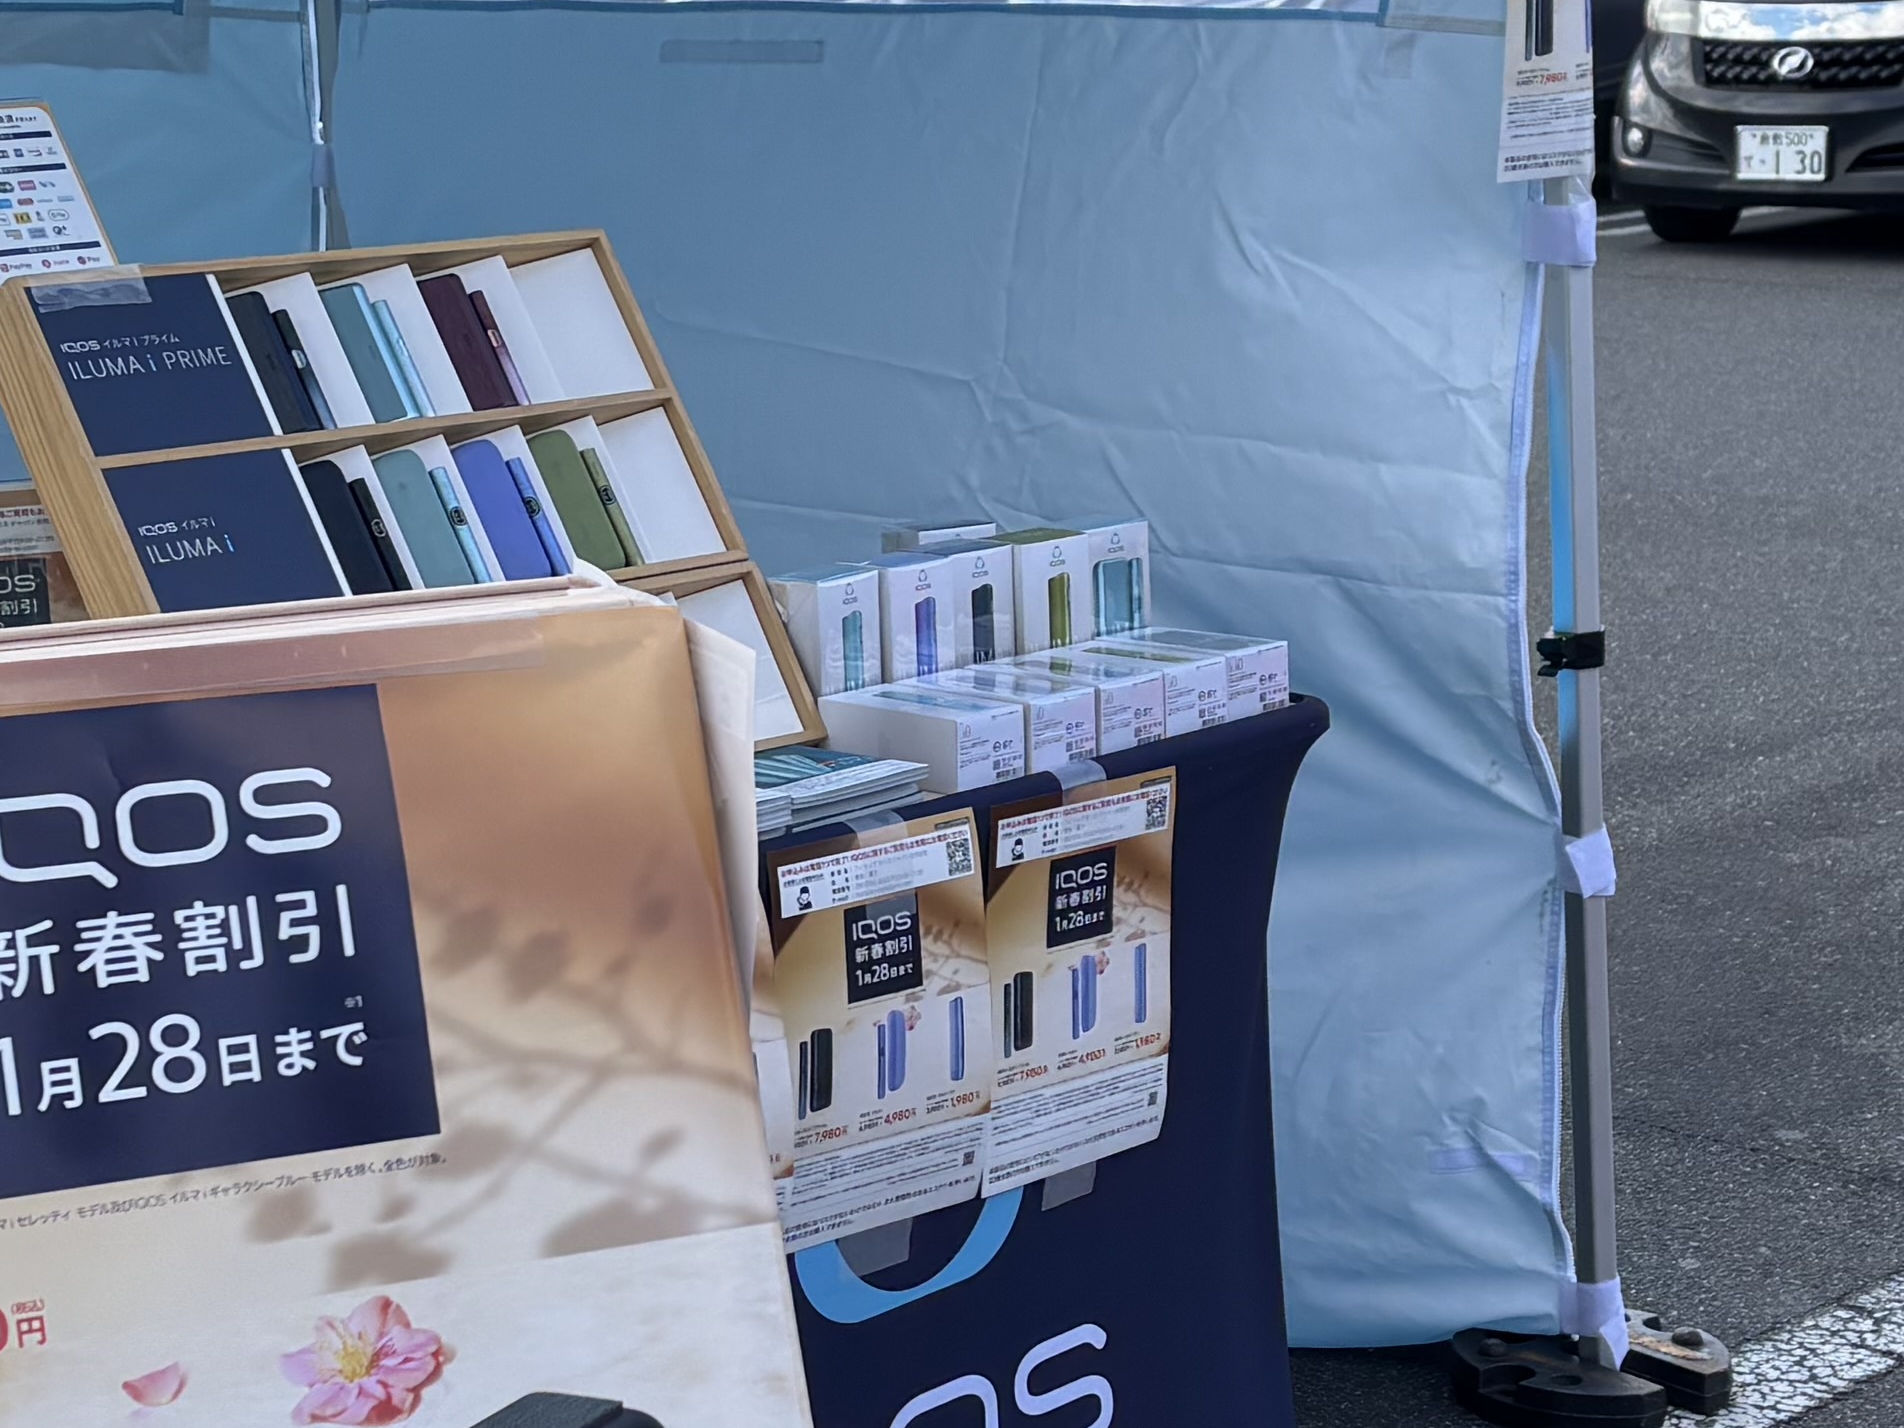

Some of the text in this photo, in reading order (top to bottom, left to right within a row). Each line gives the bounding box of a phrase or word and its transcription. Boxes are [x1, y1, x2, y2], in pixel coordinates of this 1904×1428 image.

[60, 340, 101, 353] IQOS
[68, 346, 232, 380] ILUMA i PRIME
[138, 522, 178, 536] IQOS
[146, 534, 234, 564] ILUMA i
[1056, 862, 1107, 890] IQOS
[1056, 885, 1106, 910] 新春割引
[853, 911, 911, 941] IQOS
[856, 935, 912, 963] 新春割引
[856, 963, 913, 986] 1月28日まで
